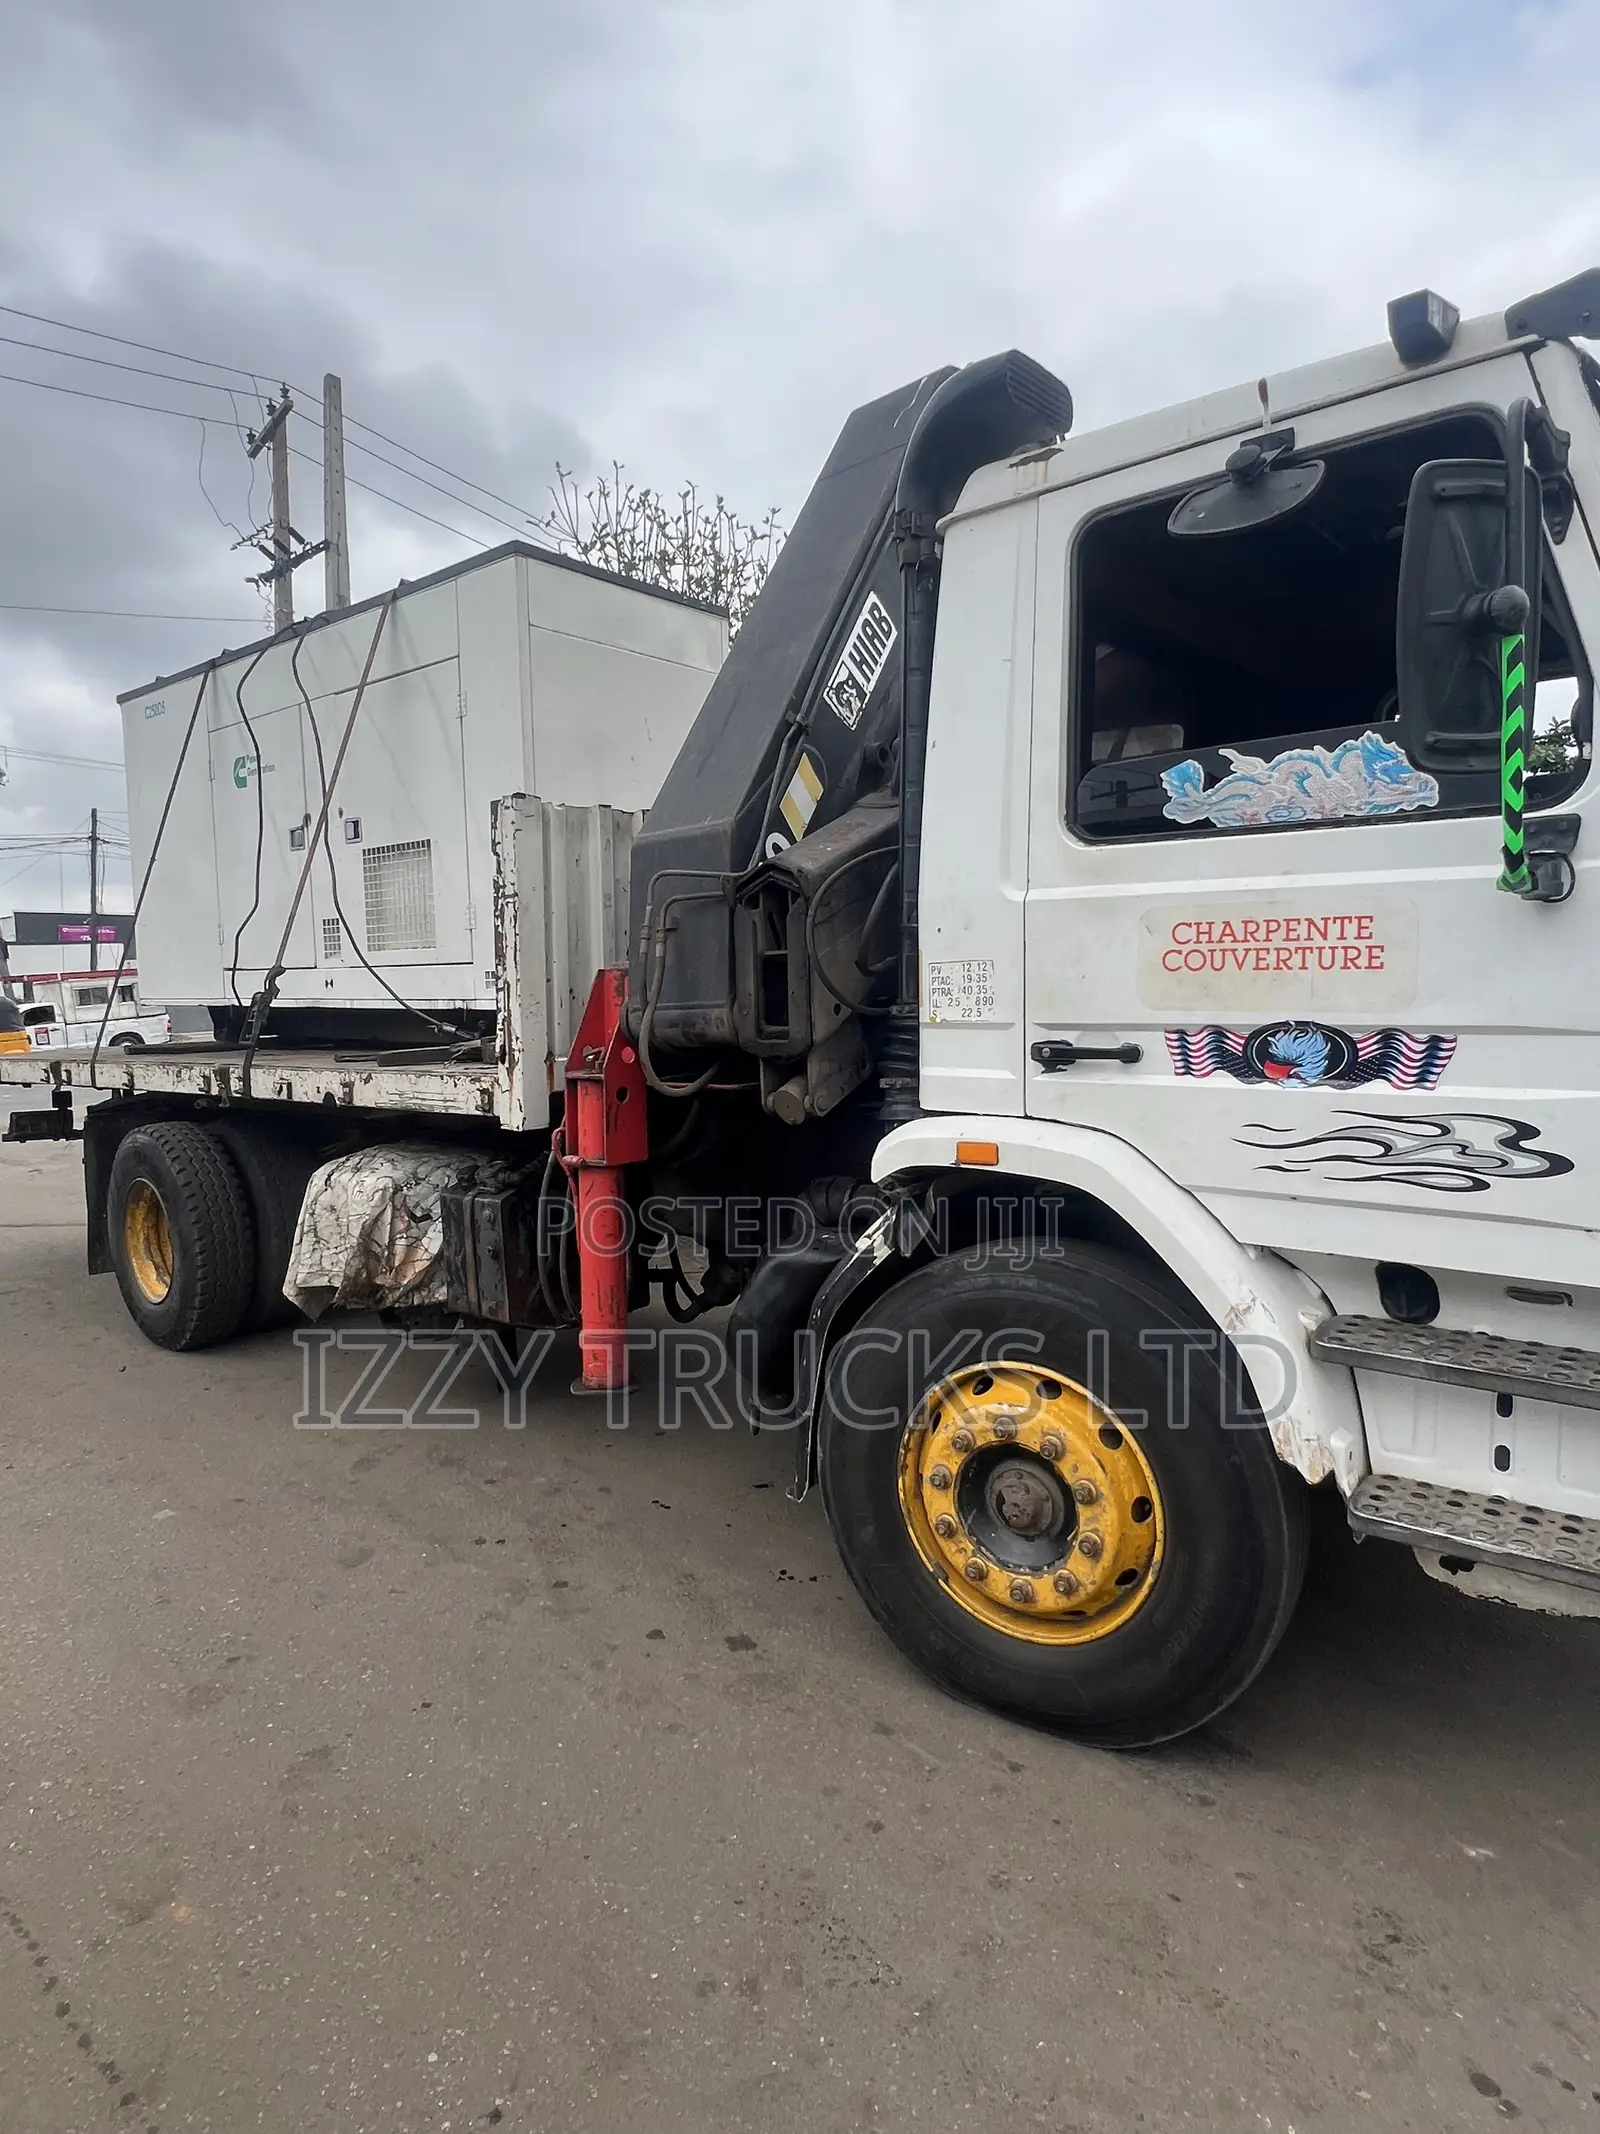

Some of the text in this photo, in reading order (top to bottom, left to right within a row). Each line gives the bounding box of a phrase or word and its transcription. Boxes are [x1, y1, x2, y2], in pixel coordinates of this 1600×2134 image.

[848, 601, 893, 685] HIAB
[1171, 915, 1374, 945] CHARPENTE
[1161, 944, 1386, 972] COUVERTURE
